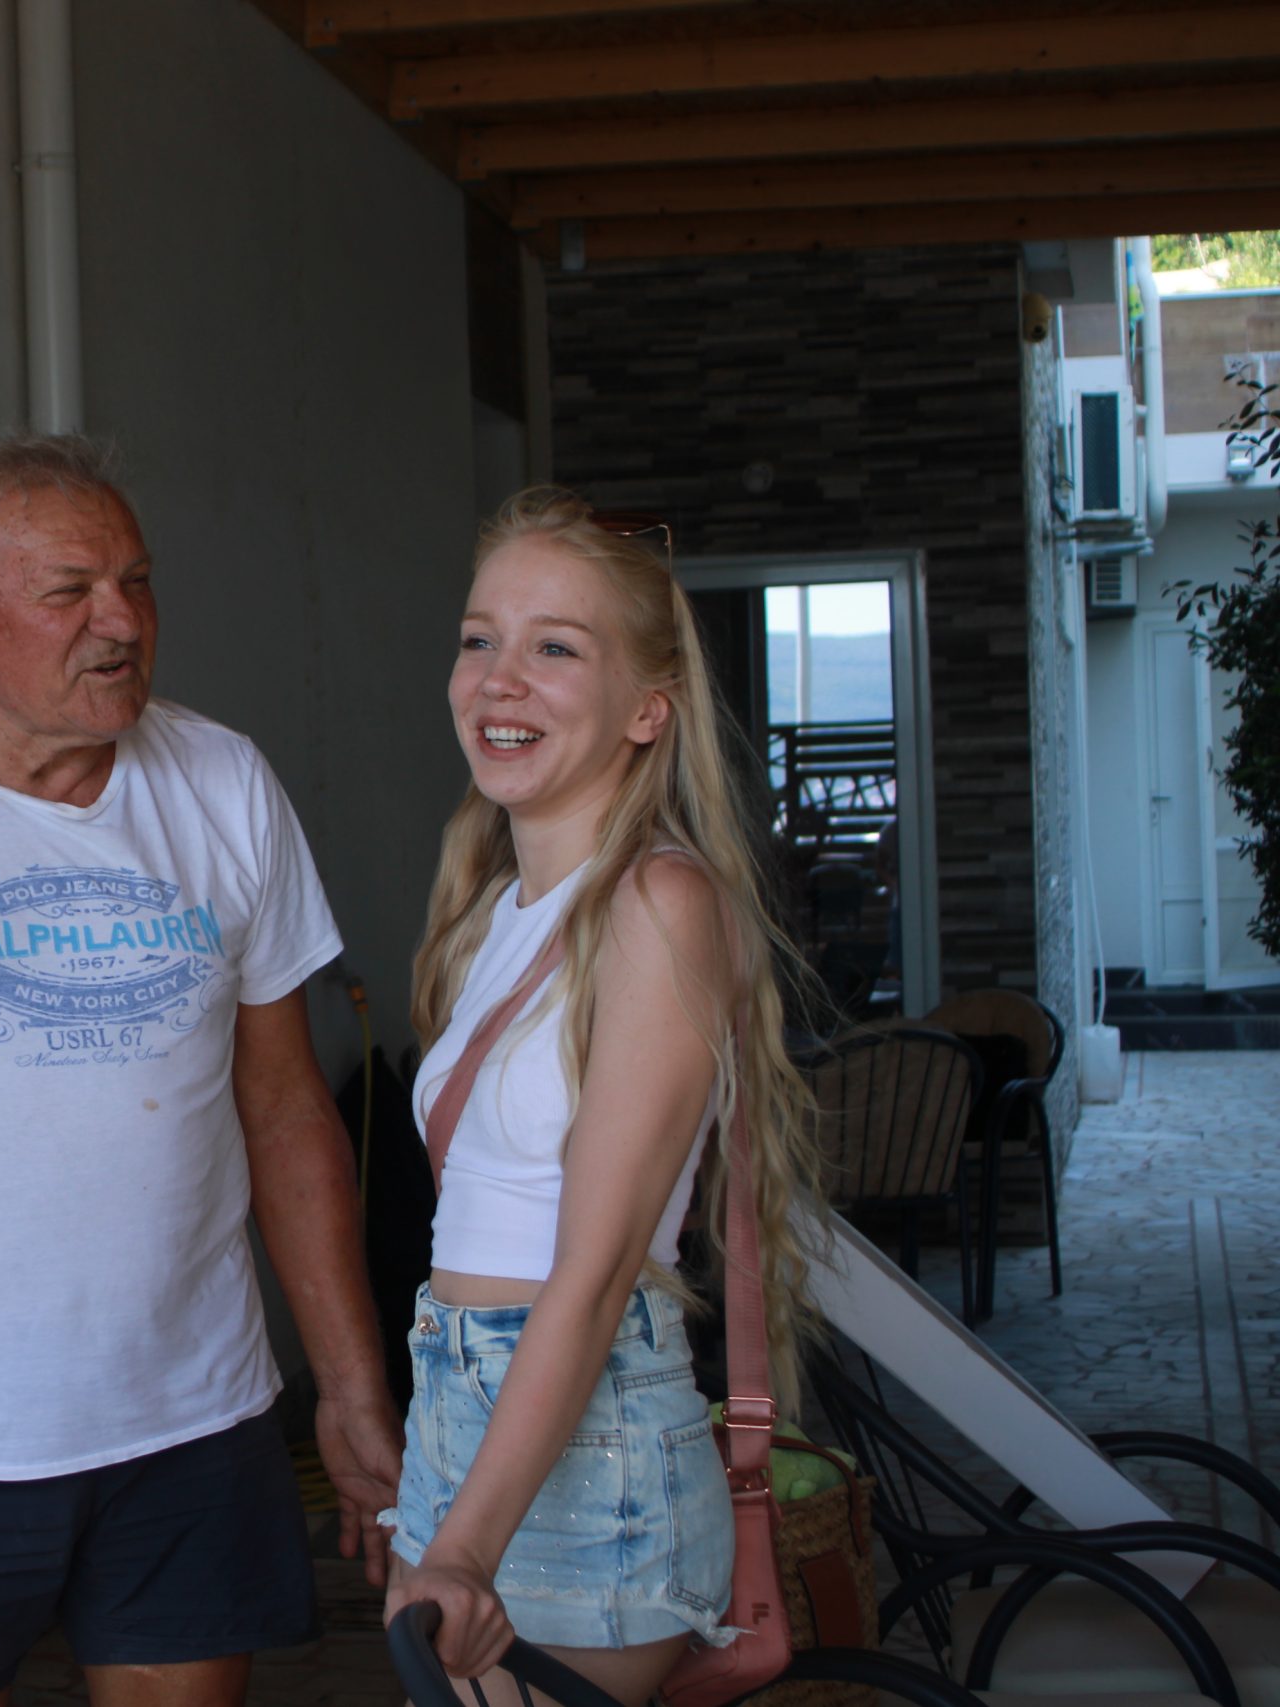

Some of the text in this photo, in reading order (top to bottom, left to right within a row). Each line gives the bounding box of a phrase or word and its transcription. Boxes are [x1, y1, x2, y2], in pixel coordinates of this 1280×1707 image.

[2, 880, 167, 905] POLO JEANS CO.
[15, 974, 179, 1009] NEW YORK CITY
[45, 1026, 143, 1050] USRL 67
